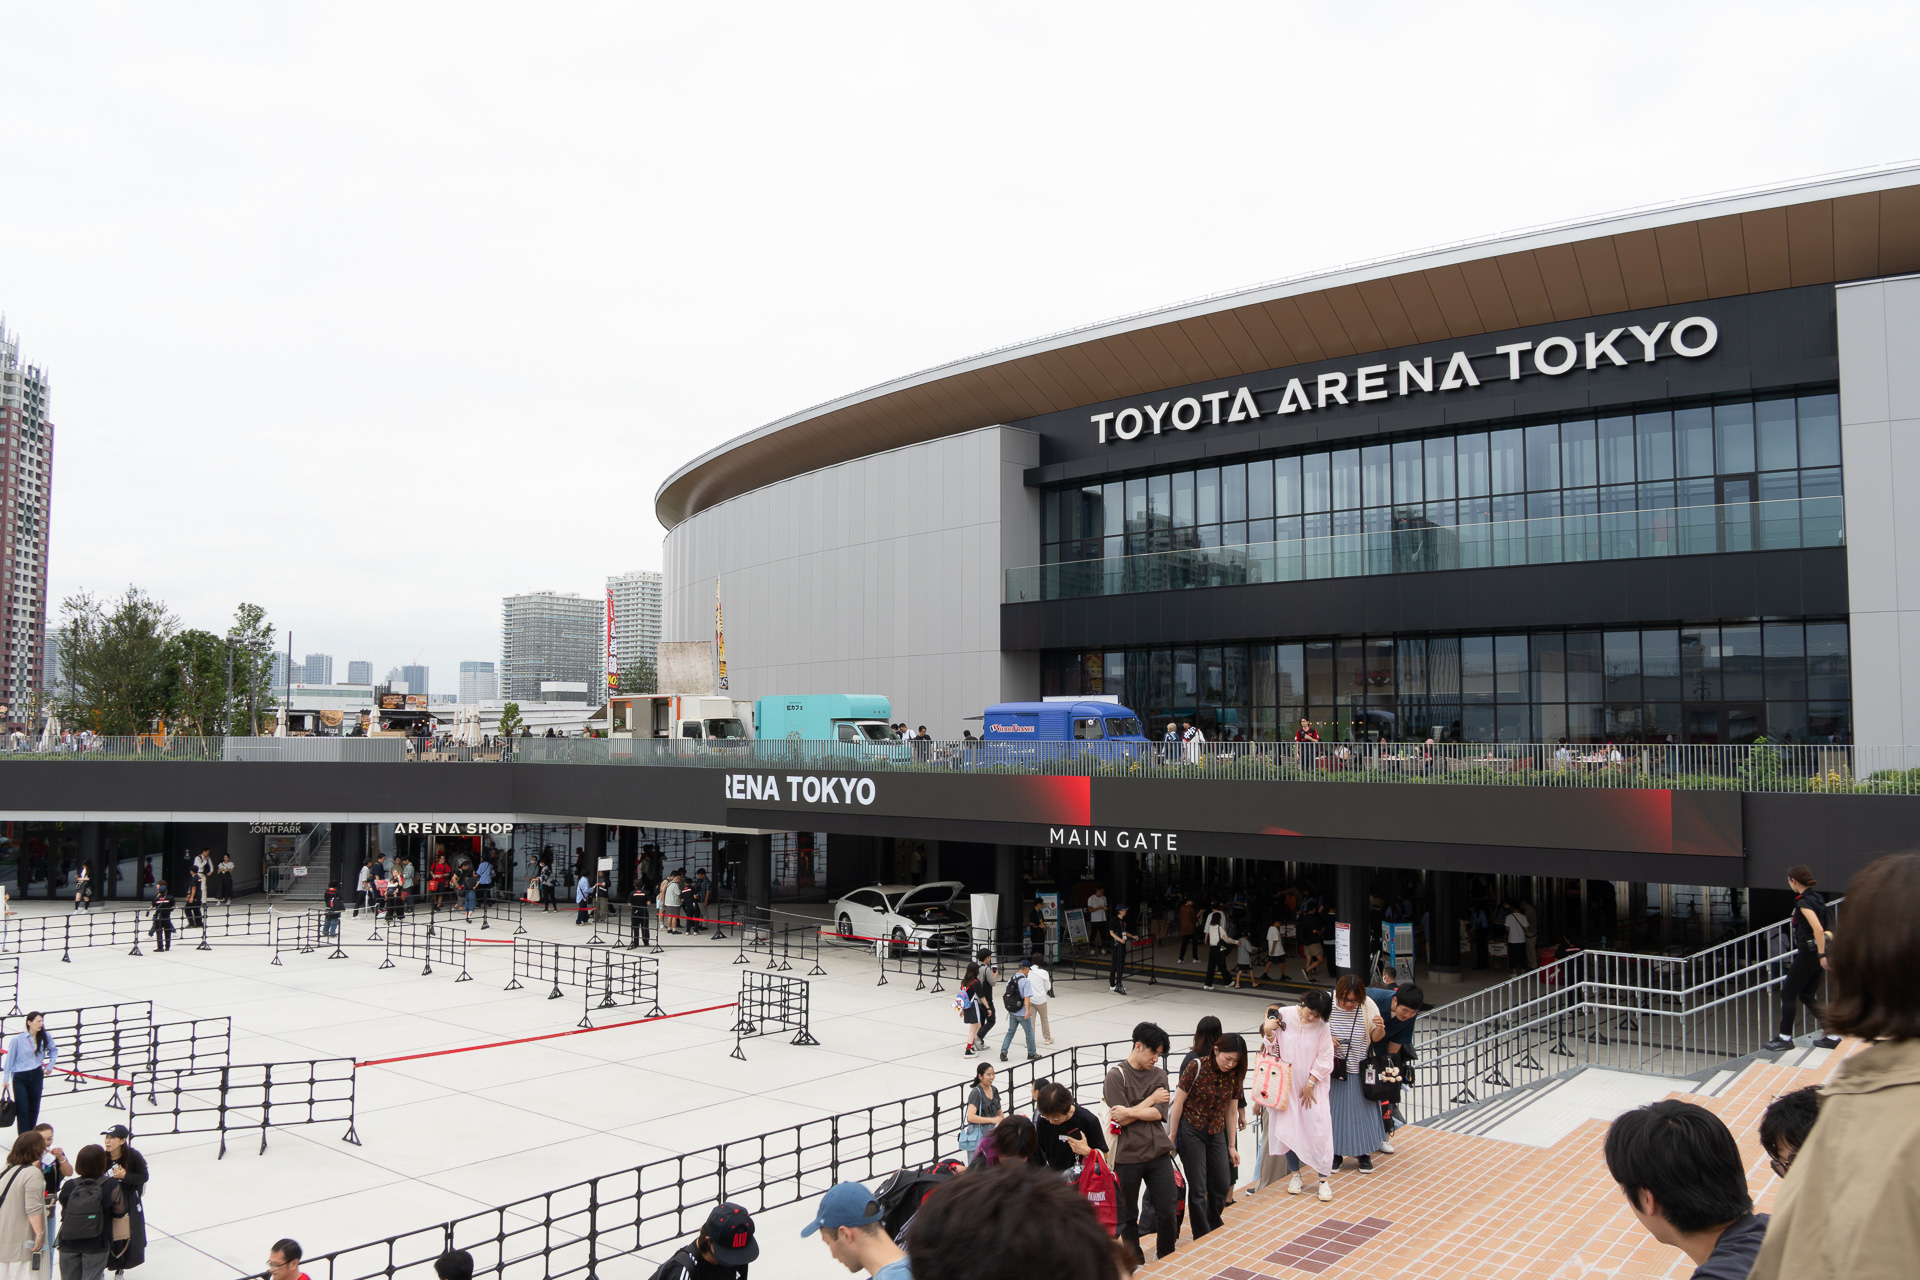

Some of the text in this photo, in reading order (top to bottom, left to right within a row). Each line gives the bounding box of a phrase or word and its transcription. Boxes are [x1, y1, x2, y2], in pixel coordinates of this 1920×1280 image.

[1090, 316, 1718, 444] TOYOTA ARENA TOKYO
[787, 776, 876, 805] TOKYO
[249, 825, 302, 834] JOINT PARK
[394, 823, 514, 834] ARENA SHOP
[1050, 827, 1177, 851] MAIN GATE
